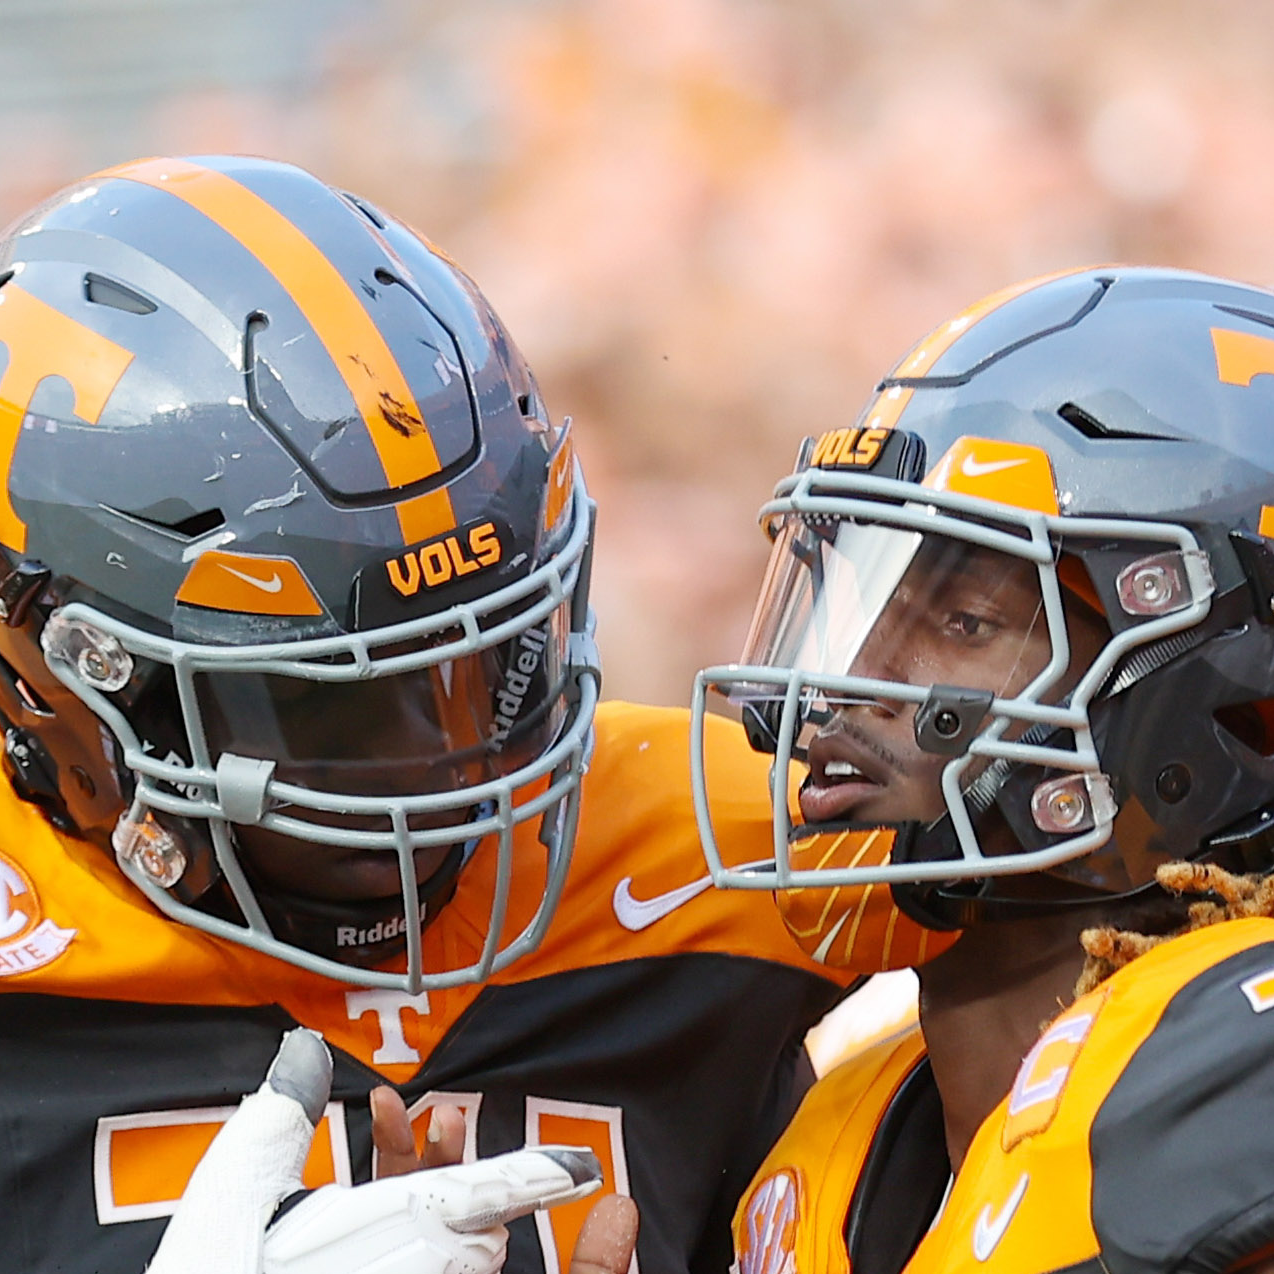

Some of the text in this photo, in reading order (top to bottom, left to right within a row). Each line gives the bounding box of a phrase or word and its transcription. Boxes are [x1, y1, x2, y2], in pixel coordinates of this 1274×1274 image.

[810, 428, 887, 467] VOLS
[386, 522, 502, 597] VOLS
[336, 903, 426, 946] Riddel
[345, 990, 430, 1065] T
[1009, 1014, 1093, 1116] C
